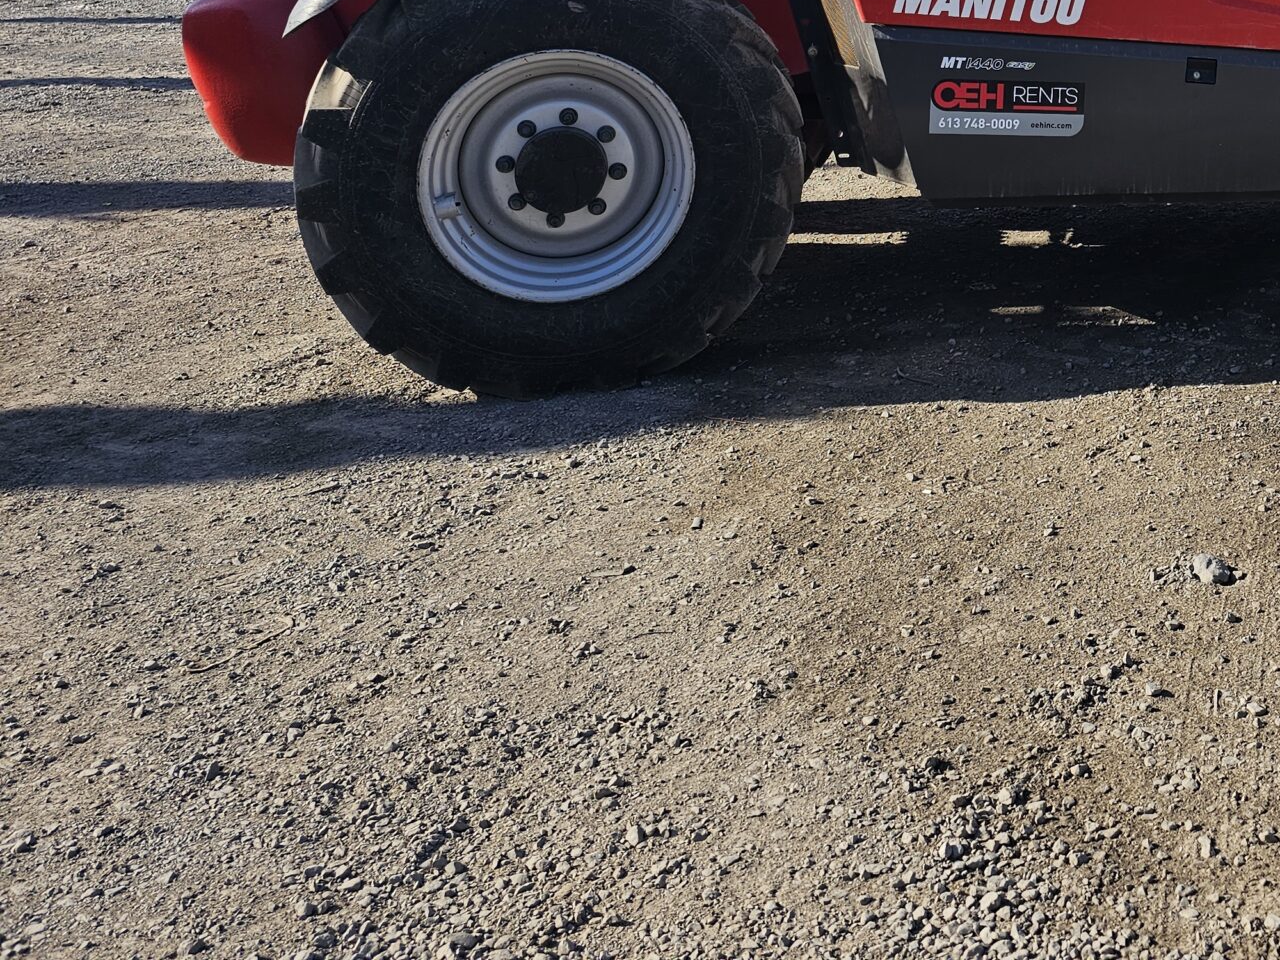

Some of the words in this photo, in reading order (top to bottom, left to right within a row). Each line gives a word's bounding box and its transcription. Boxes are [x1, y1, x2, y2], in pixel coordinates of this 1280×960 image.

[933, 81, 1005, 110] OEH
[1013, 86, 1078, 105] RENTS
[938, 117, 961, 129] 613
[963, 117, 1020, 130] 748-0009
[1030, 122, 1072, 130] oehinc.com
